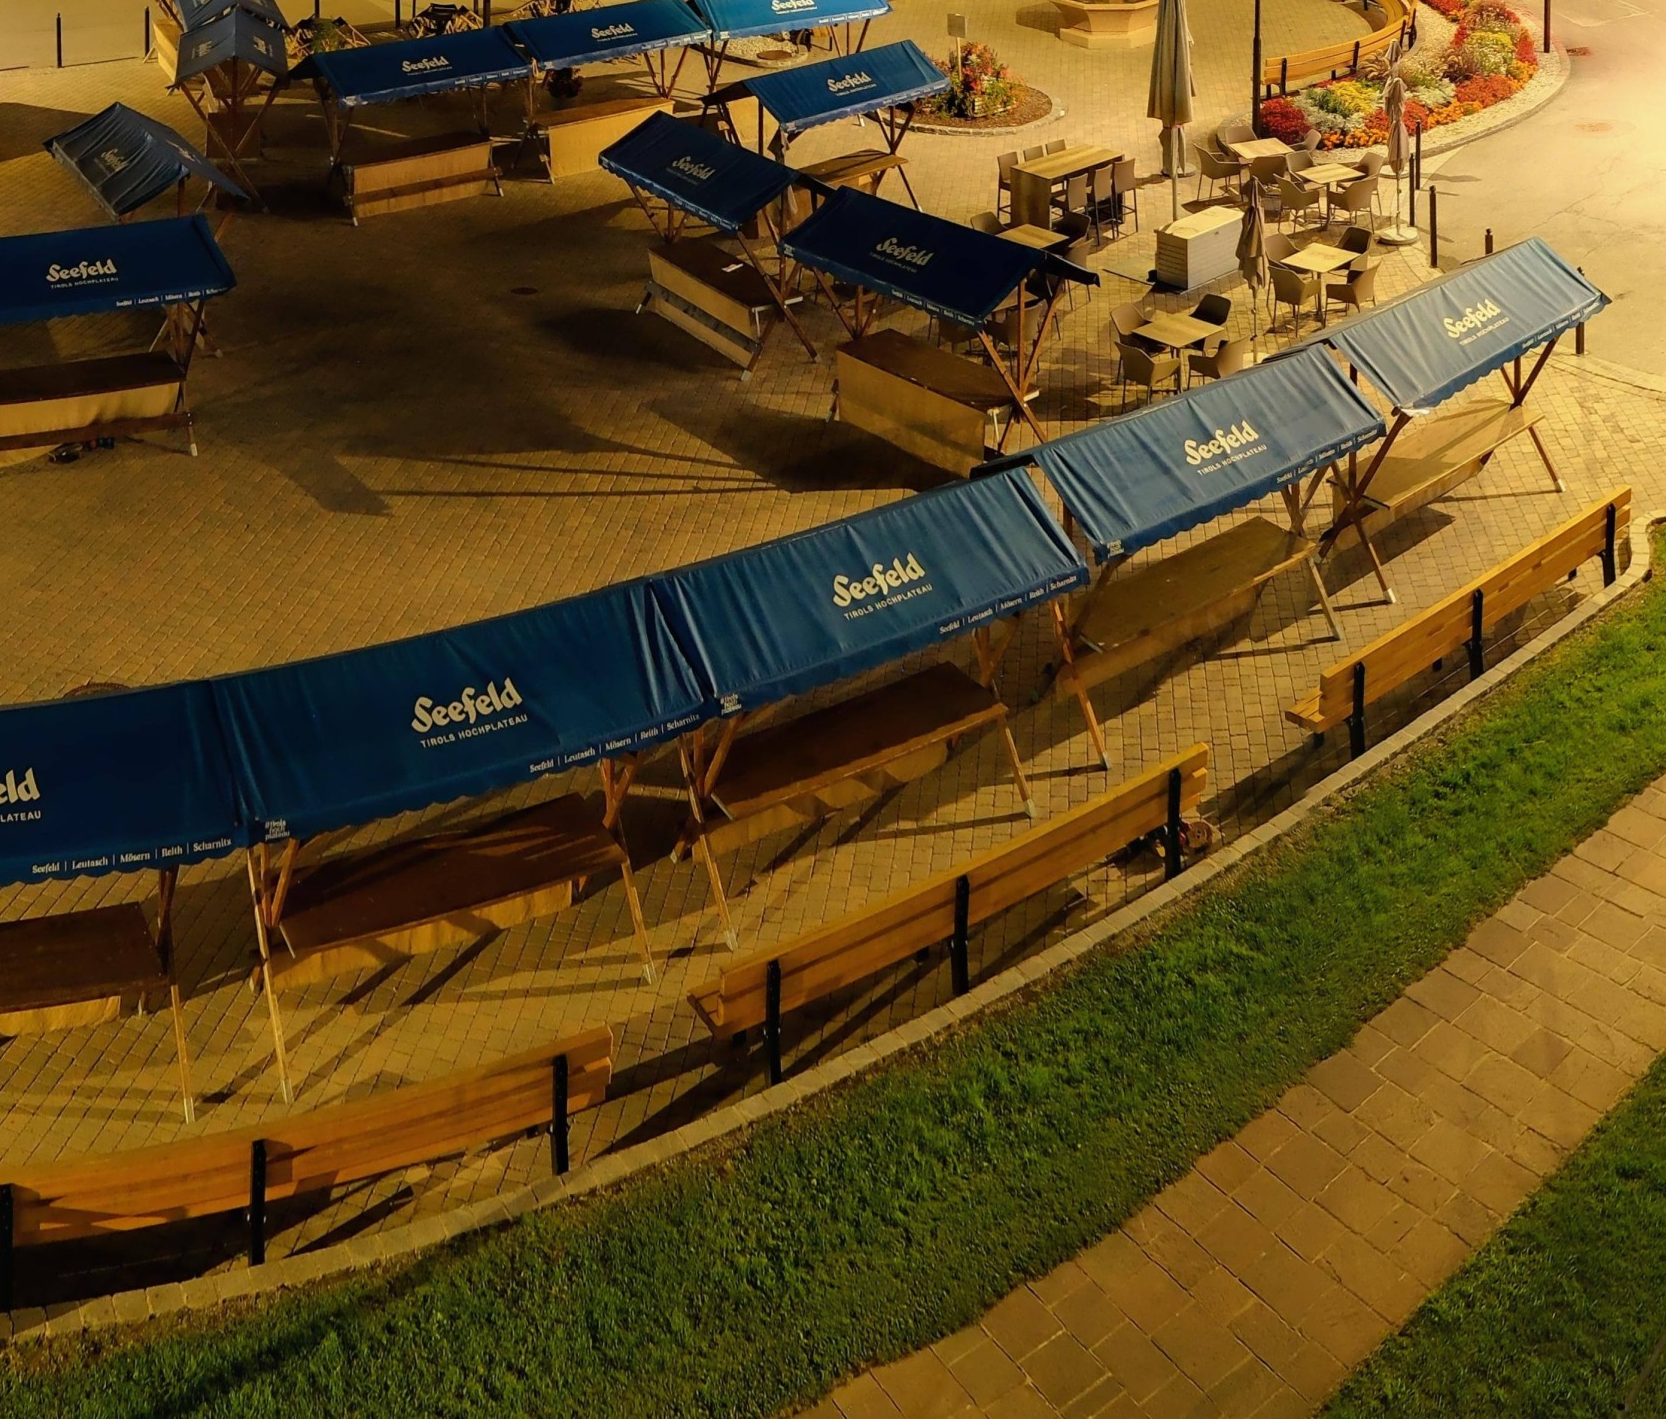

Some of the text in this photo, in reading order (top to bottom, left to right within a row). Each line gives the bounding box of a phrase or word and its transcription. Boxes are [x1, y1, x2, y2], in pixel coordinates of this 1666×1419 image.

[592, 23, 634, 39] Seefeld
[402, 56, 449, 72] Seefeld
[827, 71, 872, 92] Seefeld
[672, 156, 716, 180] Seefeld
[876, 237, 934, 266] Seefeld
[46, 258, 117, 282] Seefeld
[1444, 298, 1501, 339] Seefeld
[1184, 420, 1260, 466] Seefeld
[1196, 444, 1268, 476] TIROLS HOCHPLATEAU
[832, 551, 926, 608] Seefeld
[843, 583, 933, 622] TIROLS HOCHPLATEAU
[411, 677, 523, 734] Seefeld
[420, 714, 528, 749] TIROLS HOCHPLATEAU
[529, 714, 701, 774] Seefeld Leutasch Mösern Reith Scharnitz
[32, 836, 232, 875] Seefeld Leutasch Mösern Reith Scharnitz
